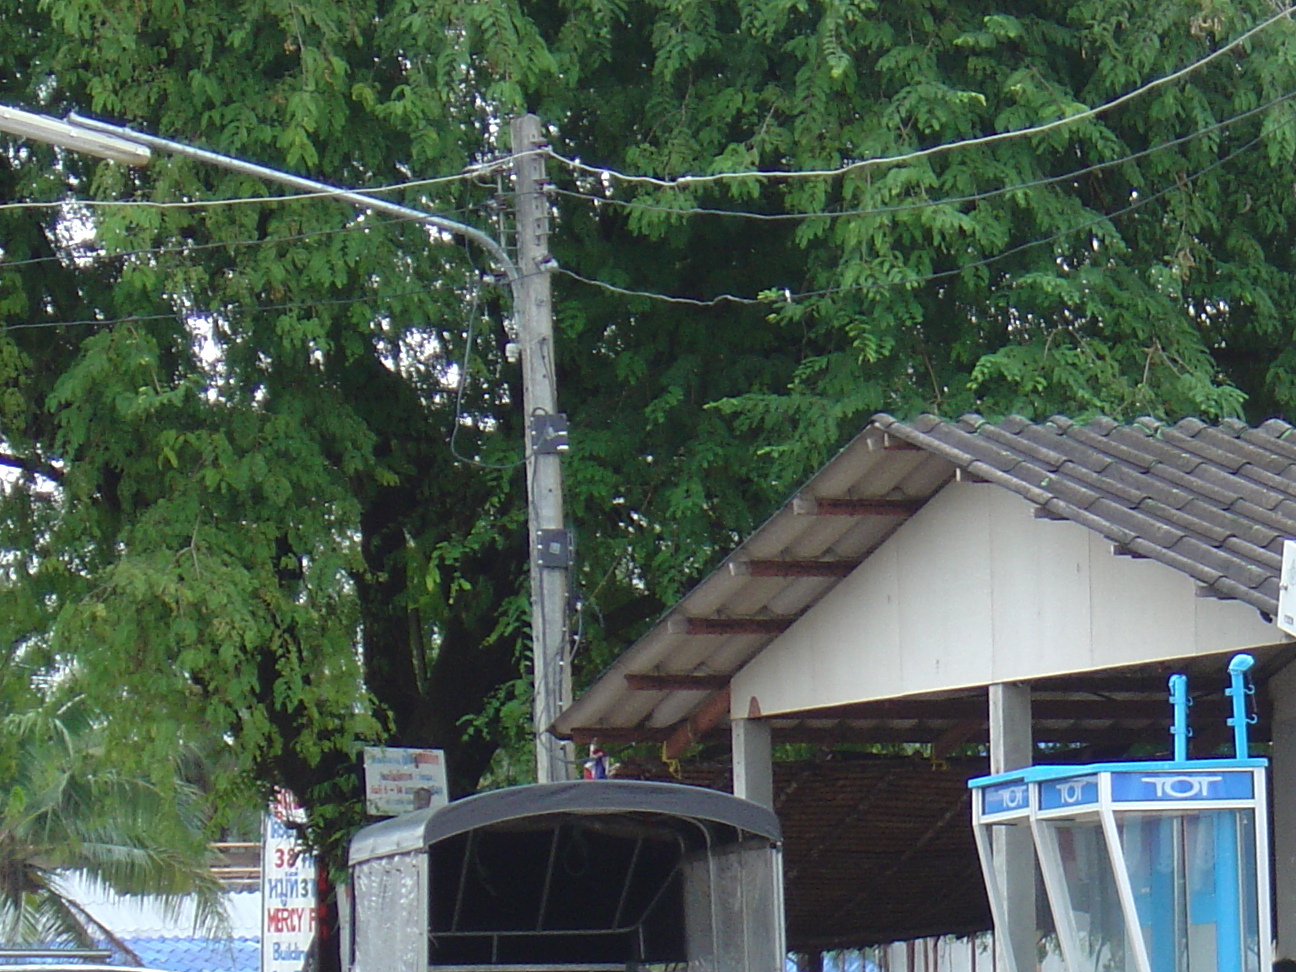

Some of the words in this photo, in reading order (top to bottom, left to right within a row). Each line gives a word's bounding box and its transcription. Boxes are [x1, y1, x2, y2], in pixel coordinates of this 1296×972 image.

[998, 786, 1028, 808] TOT
[1056, 780, 1088, 803] TOT
[1142, 776, 1223, 798] TOT
[267, 907, 304, 933] MERCY
